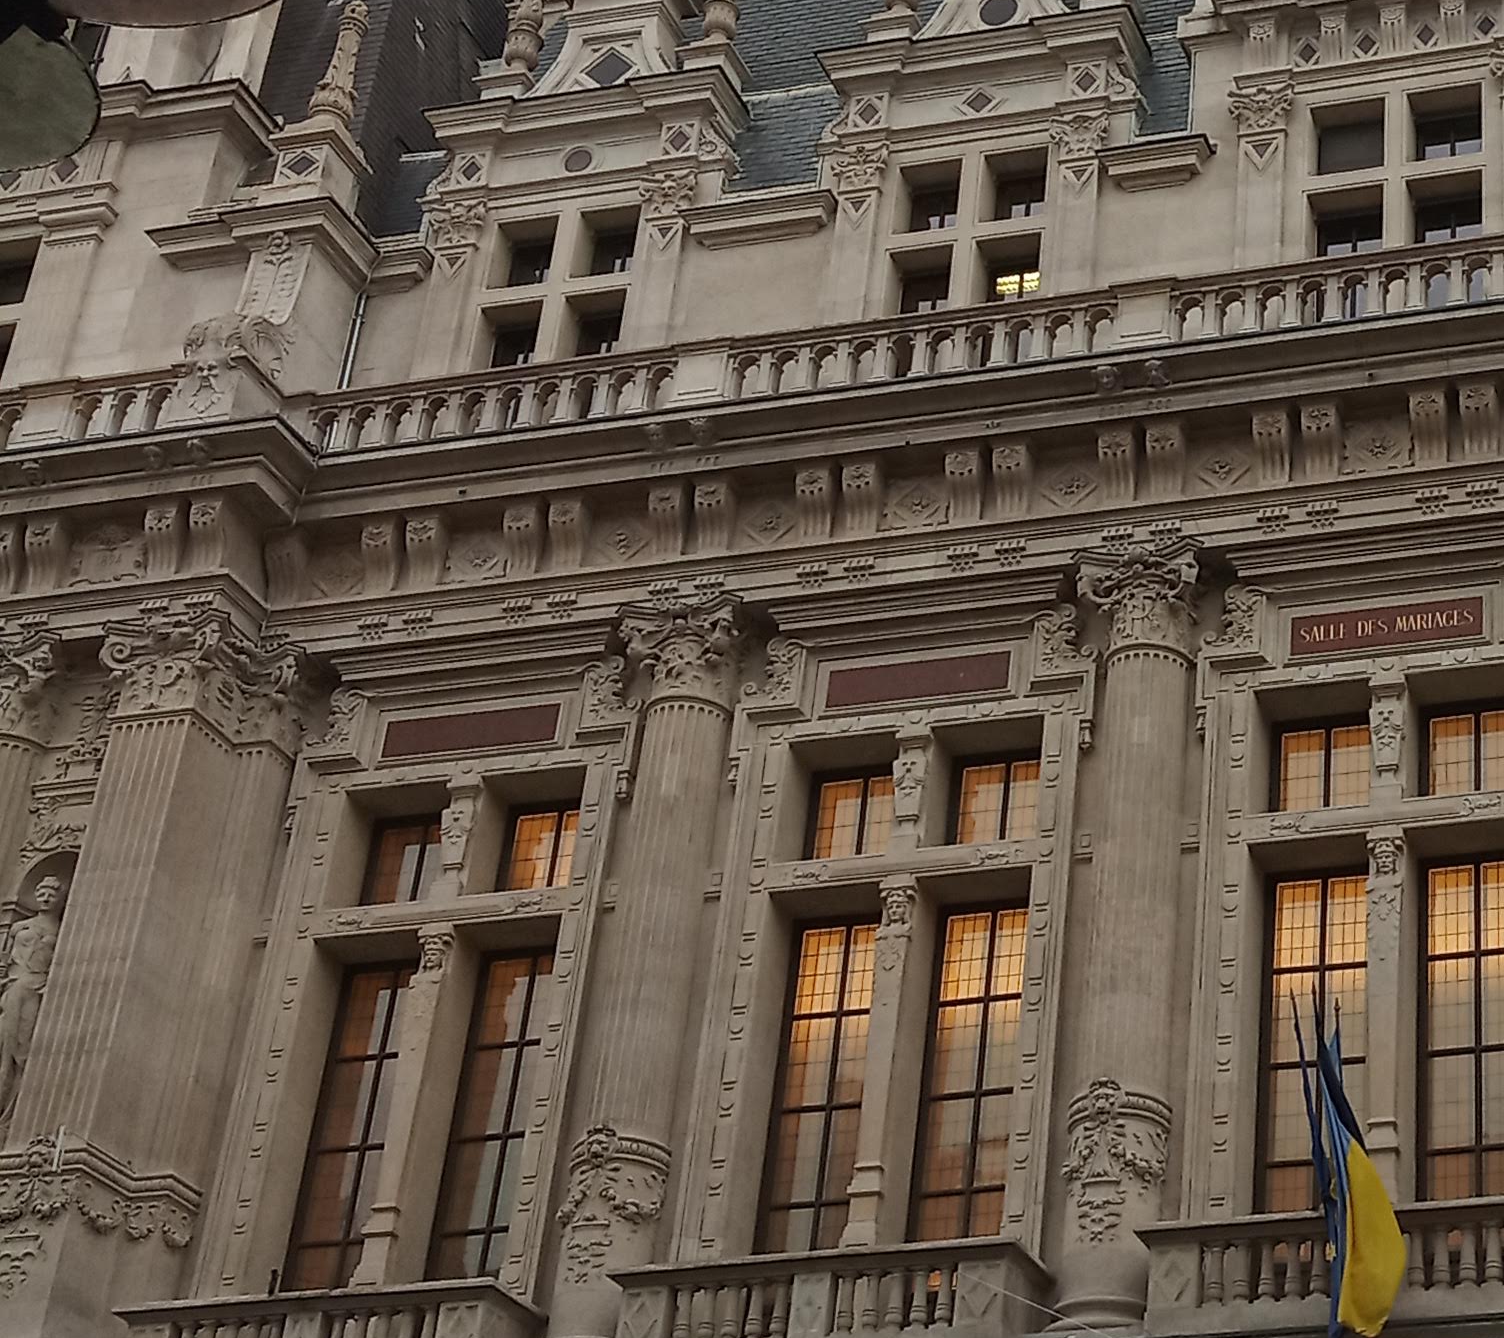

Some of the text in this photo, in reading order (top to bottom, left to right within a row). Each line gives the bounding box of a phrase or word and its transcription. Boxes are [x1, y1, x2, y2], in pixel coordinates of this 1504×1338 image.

[1299, 608, 1474, 643] SALLE DES MARIAGES
